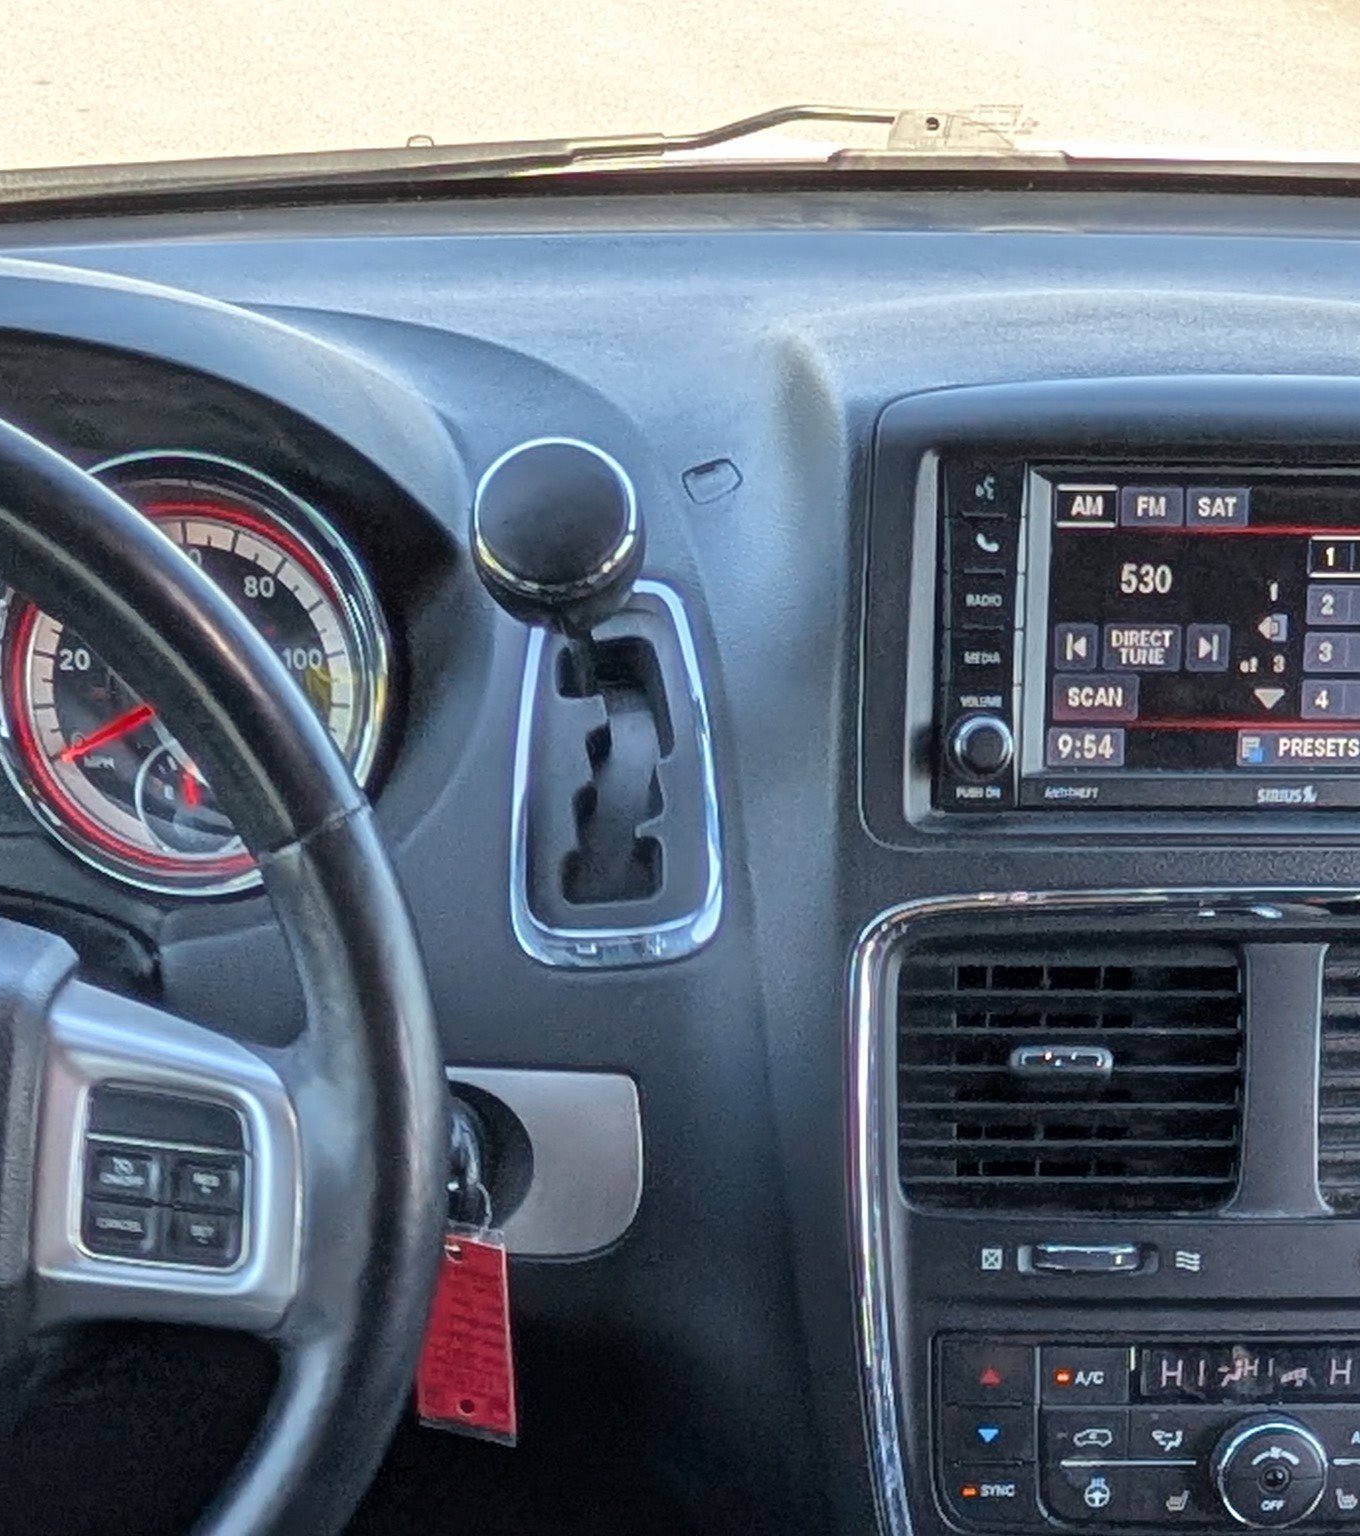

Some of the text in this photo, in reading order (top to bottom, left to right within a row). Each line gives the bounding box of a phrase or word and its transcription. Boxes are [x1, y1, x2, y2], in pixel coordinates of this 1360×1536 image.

[1071, 495, 1103, 516] AM
[1136, 496, 1166, 517] FM
[1198, 496, 1237, 517] SAT
[1324, 546, 1336, 567] 1
[243, 575, 276, 598] 80
[1120, 563, 1173, 595] 530
[966, 593, 1003, 607] RADIO
[1268, 581, 1279, 601] 1
[1320, 594, 1335, 616] 2
[1111, 629, 1174, 648] DIRECT
[58, 648, 91, 671] 20
[282, 648, 322, 670] 100
[1119, 648, 1166, 666] TUNE
[1318, 641, 1333, 662] 3
[1273, 654, 1286, 673] 3
[1068, 686, 1123, 708] SCAN
[1314, 689, 1330, 710] 4
[1057, 733, 1114, 760] 9:54
[1278, 737, 1360, 758] PRESETS
[1074, 1370, 1104, 1387] A/C
[979, 1484, 1016, 1498] SYNC
[1260, 1500, 1286, 1512] OFF
